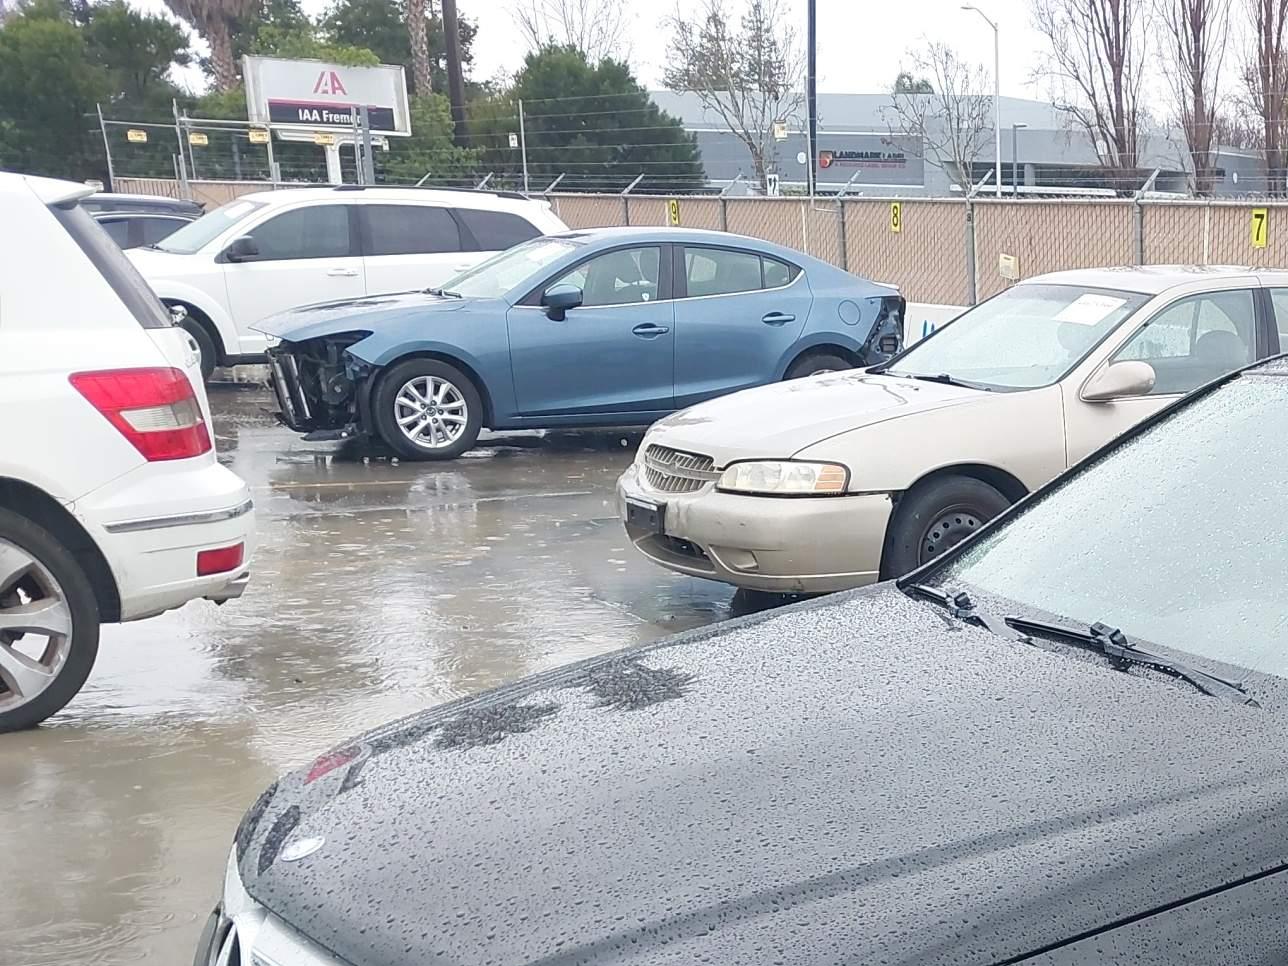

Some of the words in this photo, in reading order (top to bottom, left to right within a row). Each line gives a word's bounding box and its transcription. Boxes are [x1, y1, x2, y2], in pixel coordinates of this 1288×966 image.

[298, 108, 321, 121] IAA
[322, 110, 362, 123] Frem
[834, 150, 881, 159] LANDMARK
[671, 202, 677, 221] 9
[892, 205, 899, 227] 8
[1254, 213, 1265, 241] 7
